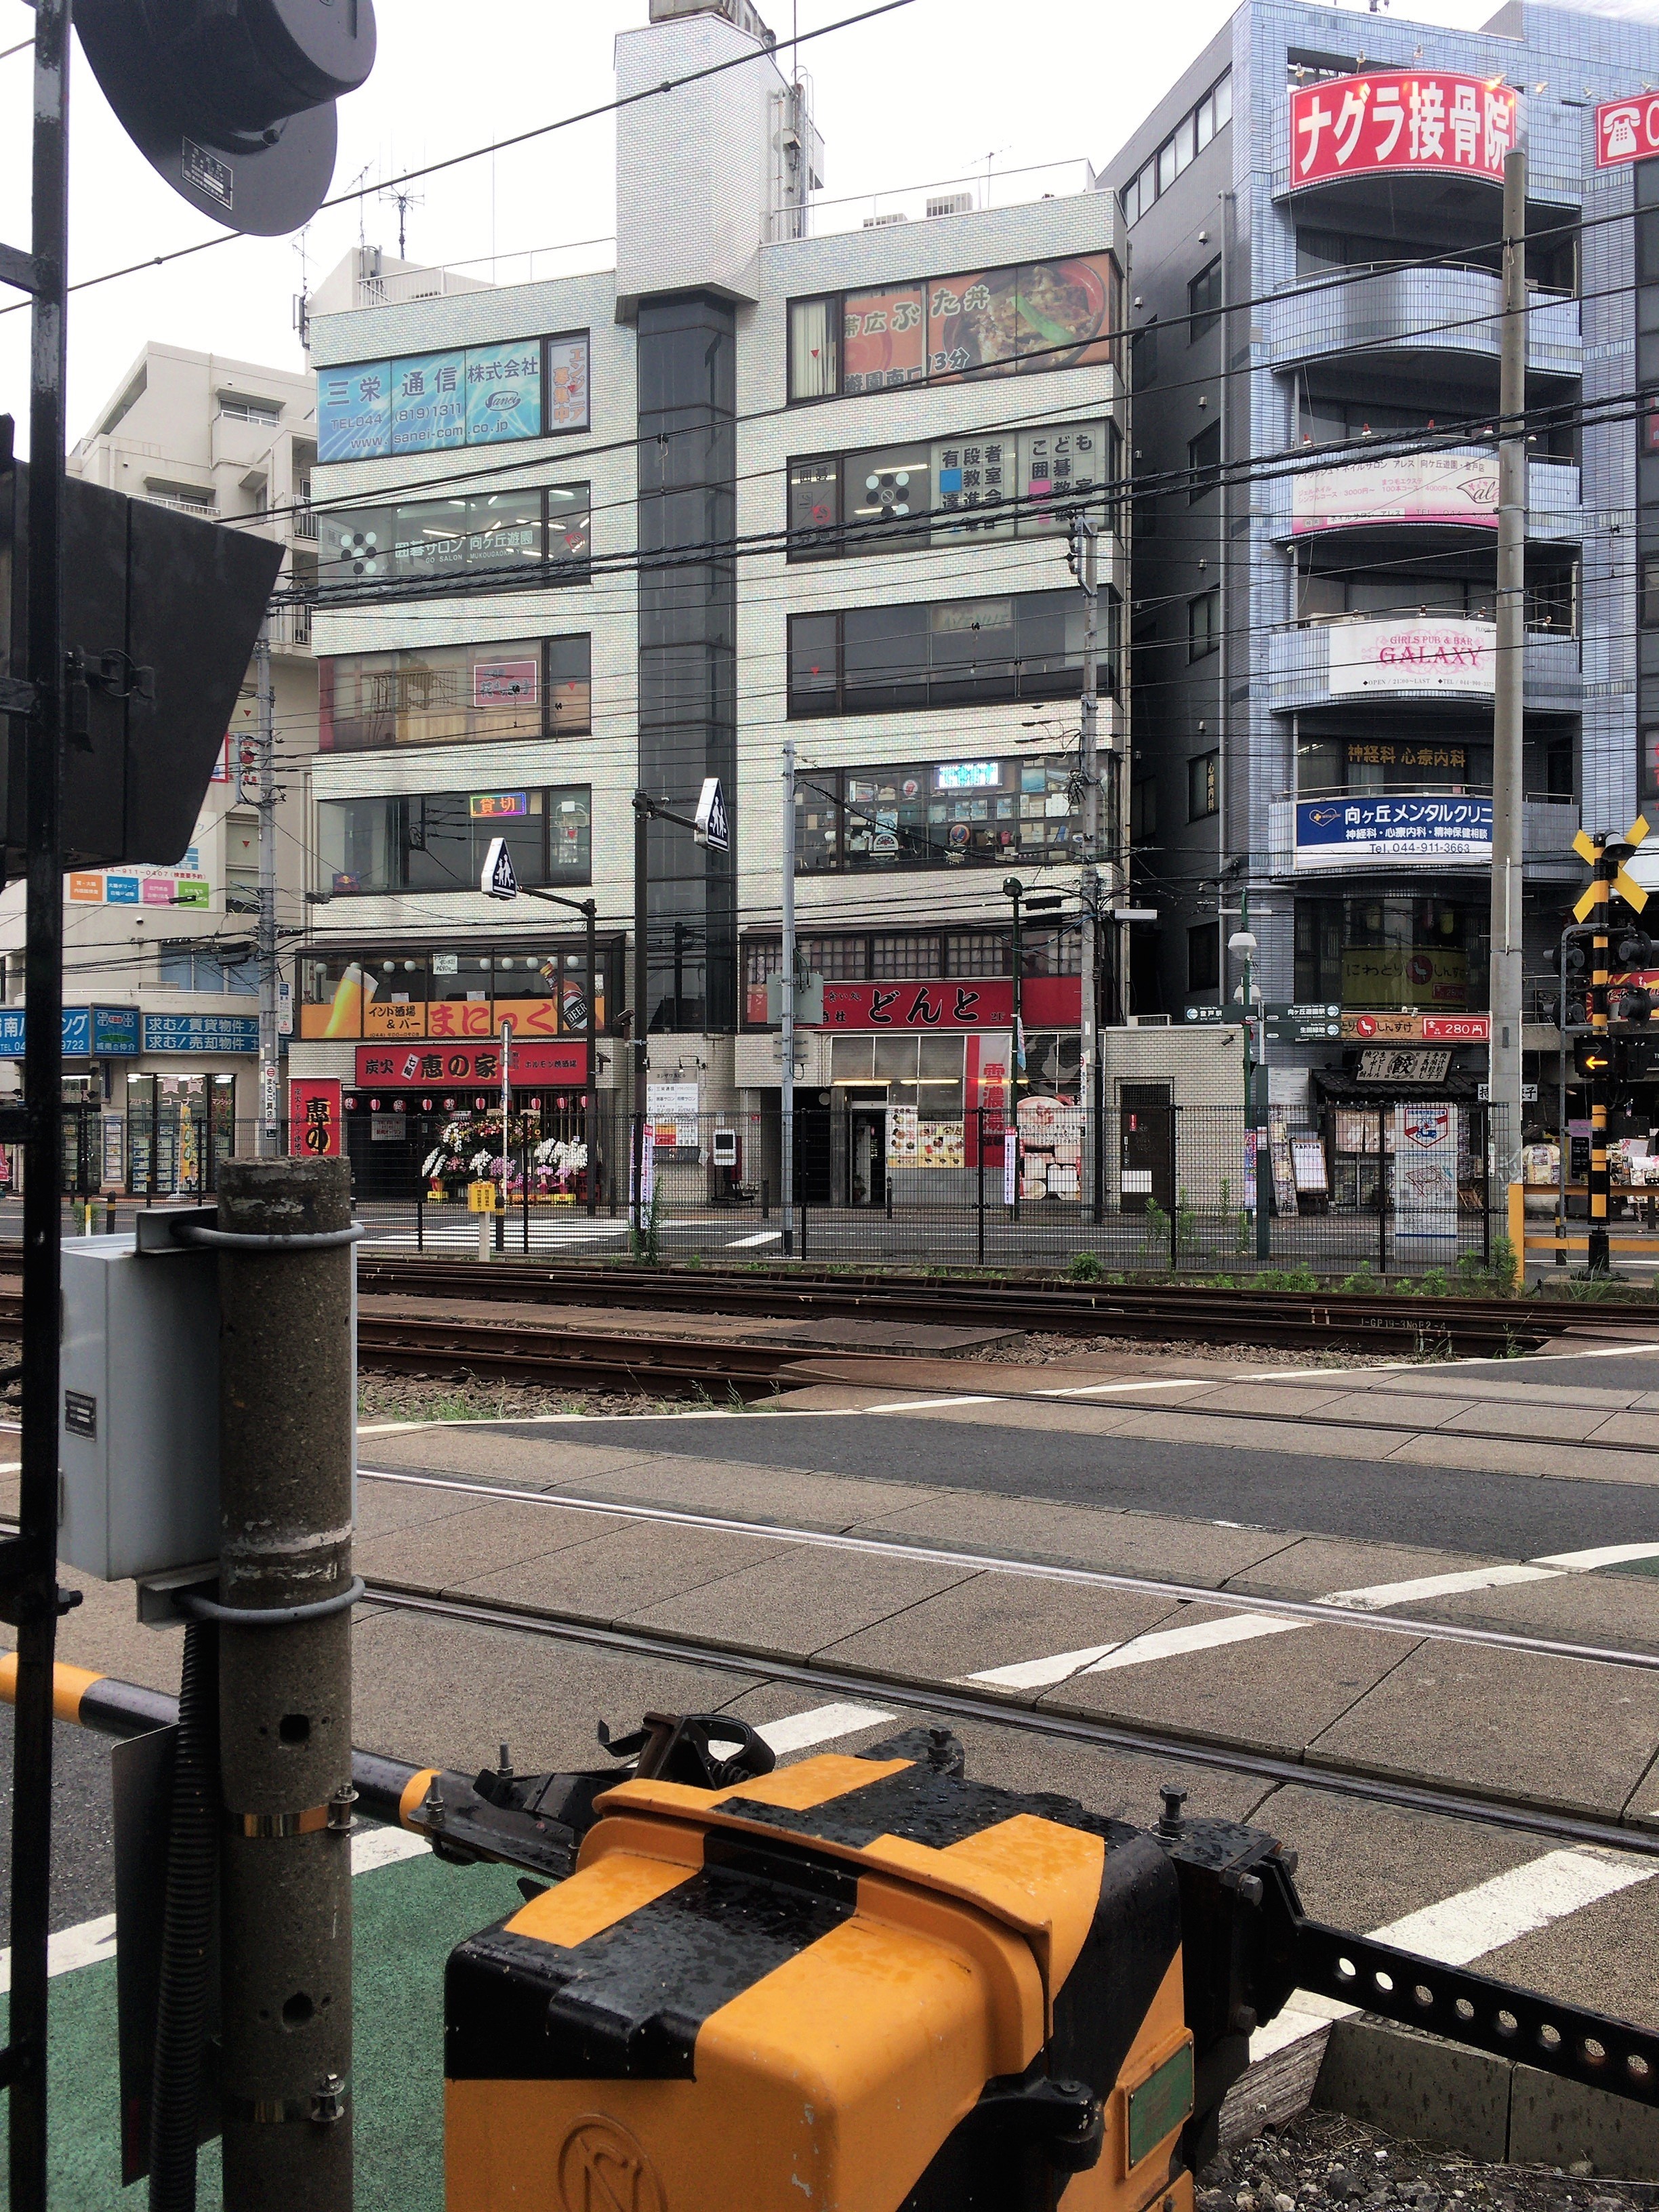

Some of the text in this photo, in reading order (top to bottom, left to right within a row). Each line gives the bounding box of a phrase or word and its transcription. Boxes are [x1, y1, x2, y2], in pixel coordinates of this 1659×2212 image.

[1298, 81, 1510, 176] ナグラ接骨院
[327, 356, 540, 407] 三栄通信 株式会社
[569, 347, 586, 422] エンジニア
[553, 366, 570, 424] 募集中
[331, 403, 462, 430] TEL044 (819)1311
[1033, 434, 1092, 456] こども
[942, 444, 1002, 469] 有段者
[1393, 460, 1415, 468] アレス
[963, 466, 1002, 489] 教室
[1031, 457, 1071, 480] 囲碁
[394, 538, 464, 558] 囲碁サロン
[439, 554, 463, 562] SALON
[1390, 636, 1420, 644] GIRLS
[1422, 636, 1441, 644] PUB
[1454, 636, 1473, 646] BAR
[1379, 645, 1483, 666] GALAXY
[1347, 744, 1467, 768] 神経科 心療内科
[479, 796, 515, 814] 貸切
[1345, 826, 1488, 840] 神経科・心療内科・精神保健相談
[1392, 842, 1471, 853] 044-911-3663
[369, 1005, 416, 1017] インド酒場
[566, 1002, 589, 1023] BEER
[868, 986, 981, 1025] どんと
[386, 1018, 421, 1029] & バー
[430, 1004, 555, 1038] まにっく
[1376, 1021, 1413, 1033] しんすけ
[1427, 1021, 1441, 1036] 全品
[1445, 1024, 1483, 1036] 280円
[365, 1059, 394, 1075] 炭火
[420, 1052, 500, 1080] 恵の家
[525, 1059, 577, 1068] ホルモン焼酒場
[1391, 1054, 1414, 1075] 餃
[161, 1078, 203, 1094] 賃貸
[162, 1097, 203, 1106] コーナー
